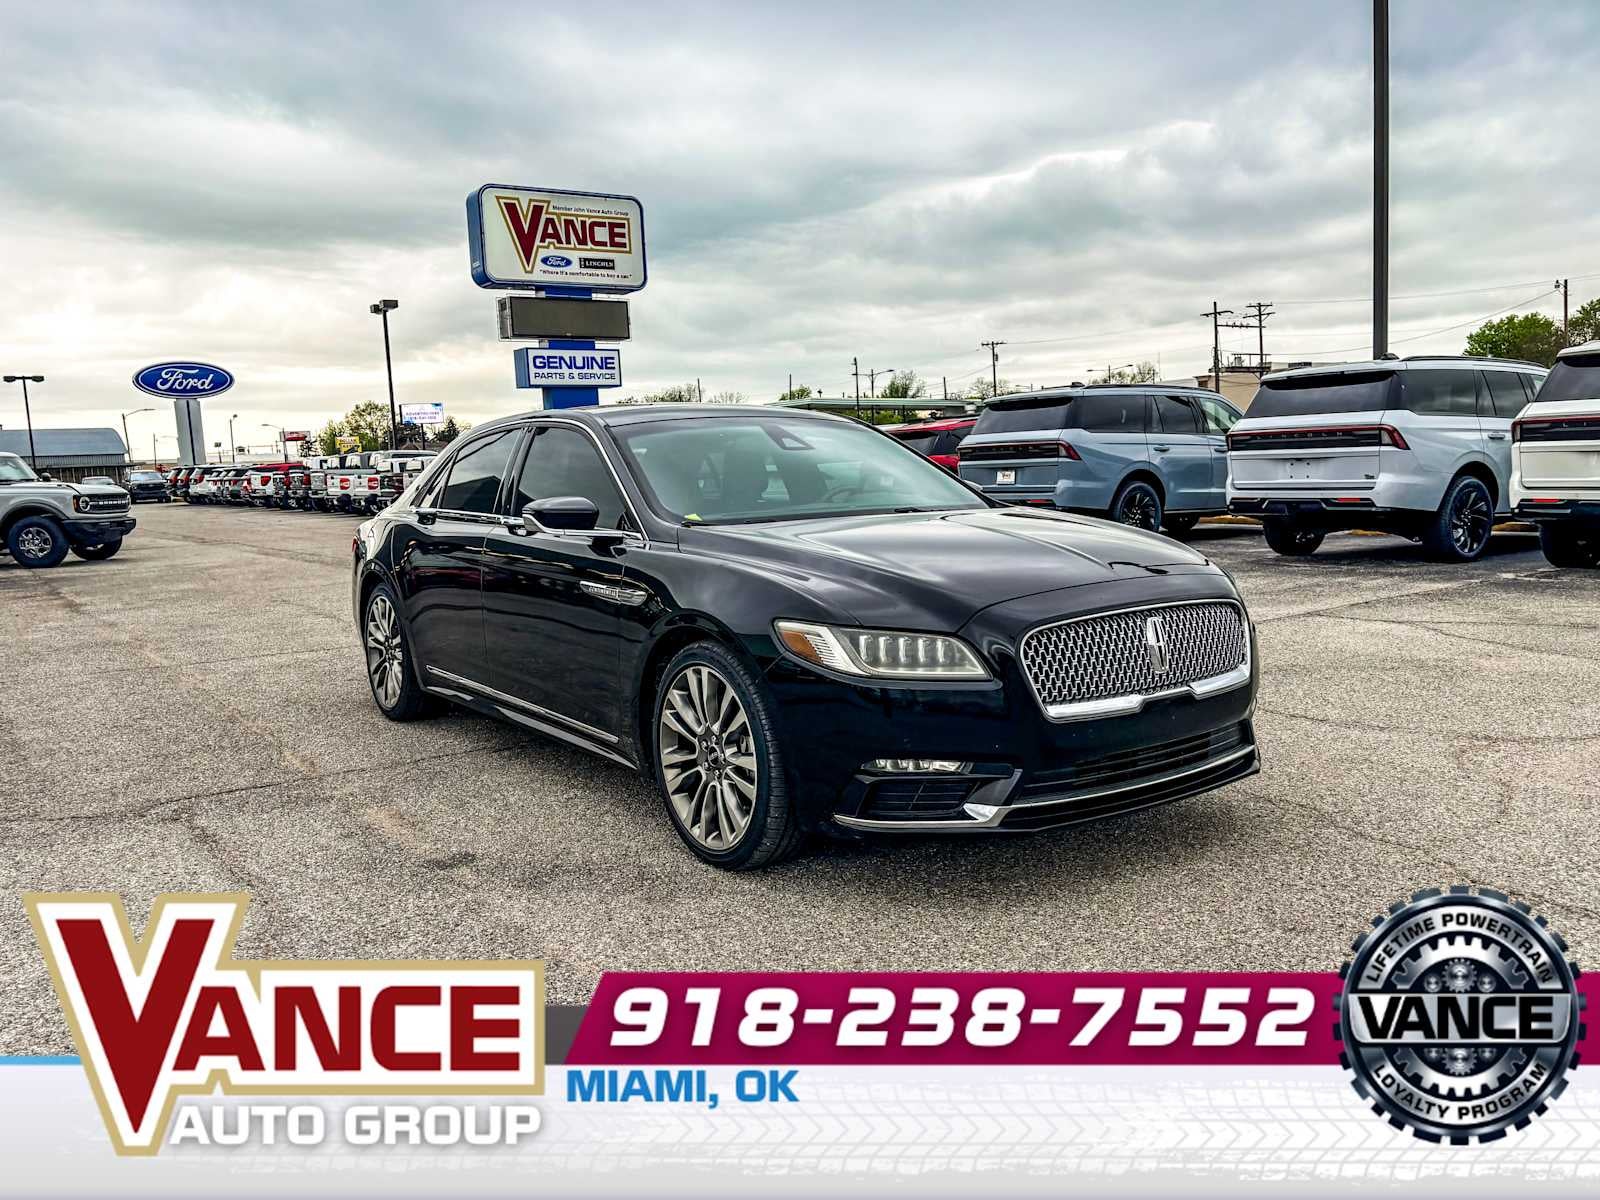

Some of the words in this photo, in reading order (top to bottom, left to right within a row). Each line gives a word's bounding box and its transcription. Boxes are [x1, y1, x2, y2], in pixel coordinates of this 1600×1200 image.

[502, 201, 628, 271] VANCE
[546, 256, 567, 266] Ford
[532, 355, 616, 370] GENUINE
[156, 368, 213, 391] Ford
[534, 372, 565, 380] PARTS
[568, 372, 575, 380] &
[577, 372, 616, 380] SERVICE
